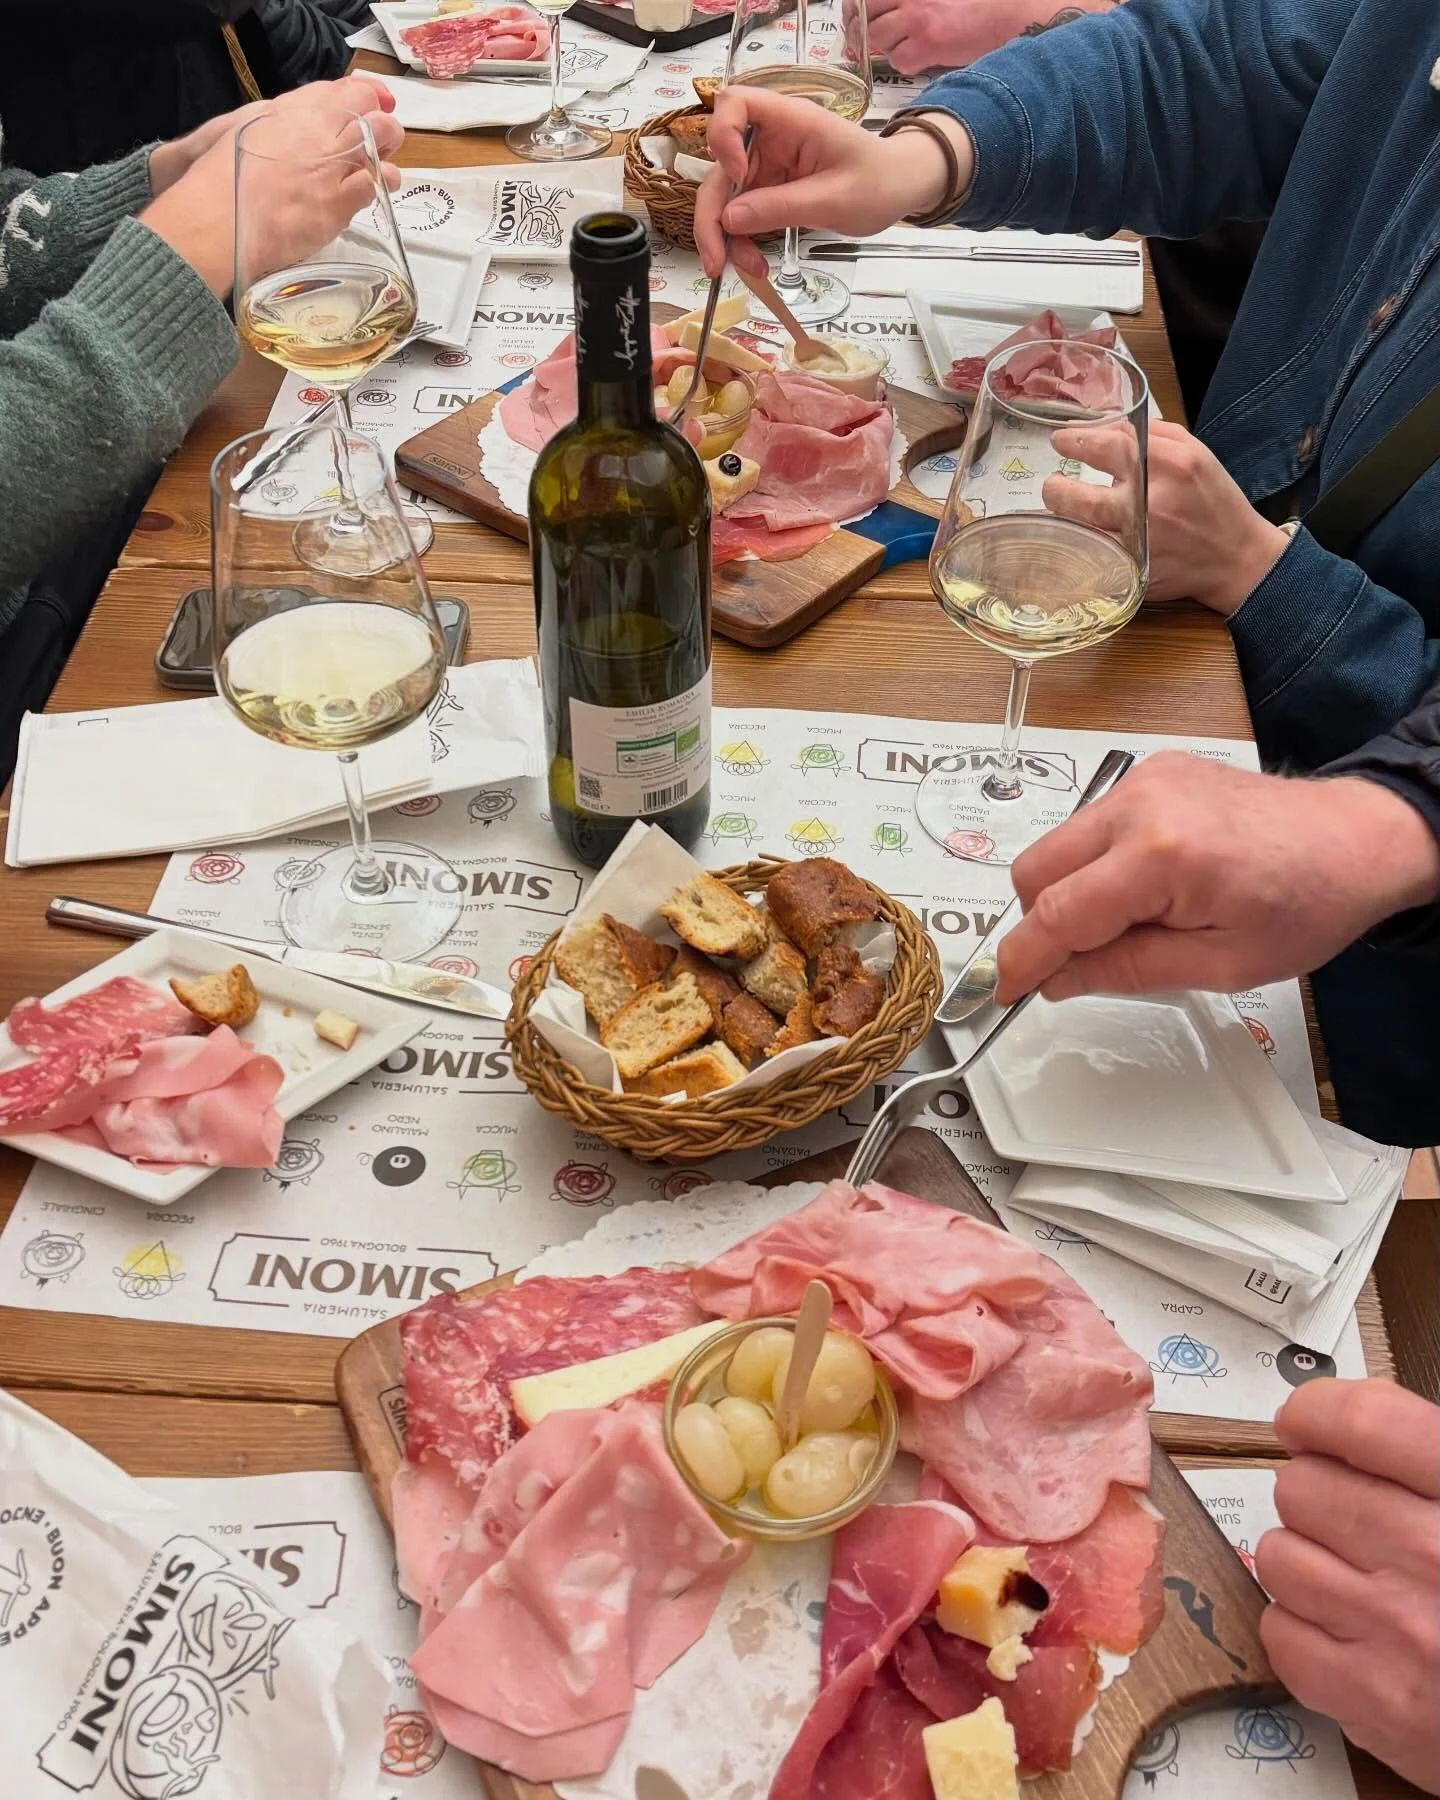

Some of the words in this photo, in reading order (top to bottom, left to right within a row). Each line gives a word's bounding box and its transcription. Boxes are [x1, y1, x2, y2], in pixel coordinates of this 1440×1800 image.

[728, 723, 766, 731] PECORA
[720, 794, 756, 802] MUCCA
[798, 799, 837, 807] PECORA
[875, 804, 912, 813] MUCCA
[385, 861, 552, 900] SIMONI
[371, 1081, 448, 1095] SALUMERIA
[475, 1125, 518, 1134] MUCCA
[350, 1240, 407, 1253] BOLOGNA
[246, 1253, 461, 1300] SIMONI
[303, 1303, 389, 1319] SALUMERIA
[1160, 1302, 1204, 1316] CAPRA
[46, 1528, 64, 1590] BUON
[71, 1554, 196, 1756] SIMONI
